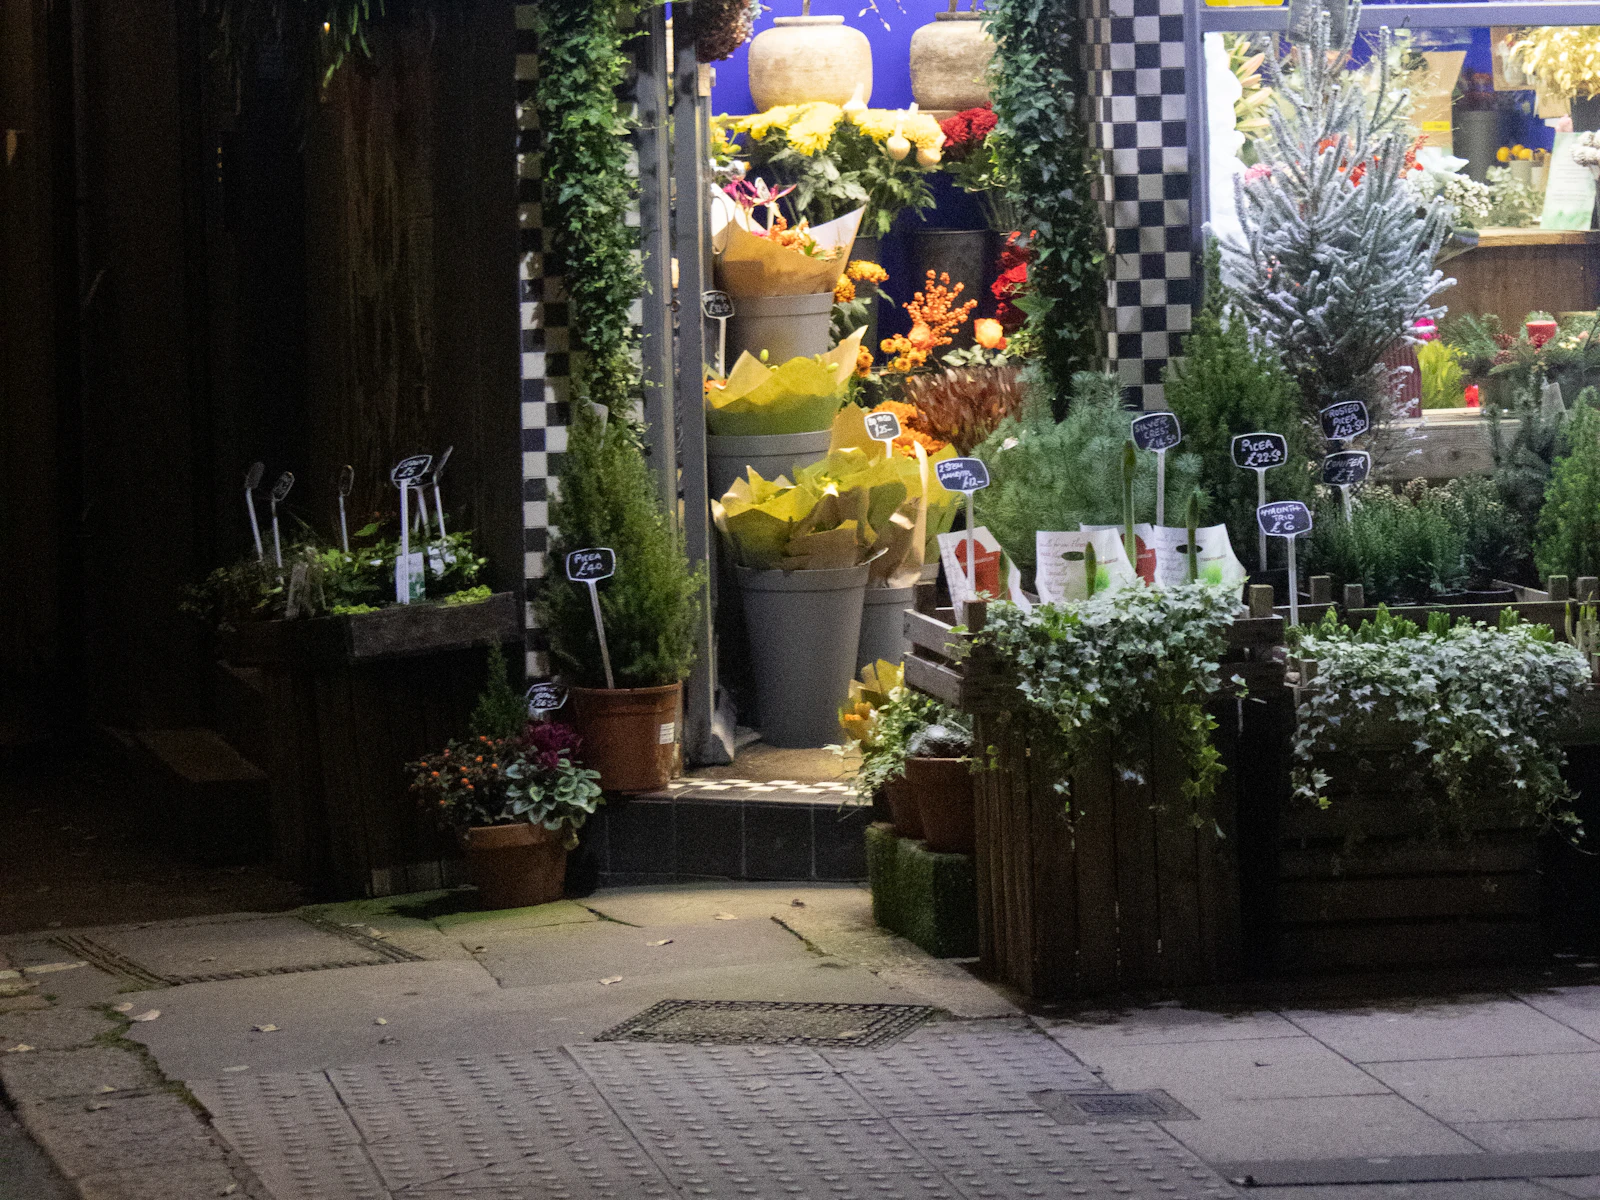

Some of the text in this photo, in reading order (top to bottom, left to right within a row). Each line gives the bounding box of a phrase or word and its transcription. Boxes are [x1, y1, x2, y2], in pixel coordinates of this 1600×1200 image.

[1134, 416, 1168, 433] SILVER
[1332, 413, 1358, 427] PICEA
[1241, 439, 1275, 452] PICEA
[1325, 456, 1366, 470] CONIFER
[1260, 504, 1302, 516] HYACINTH
[1271, 513, 1295, 521] TRIO
[574, 553, 602, 564] PICEA
